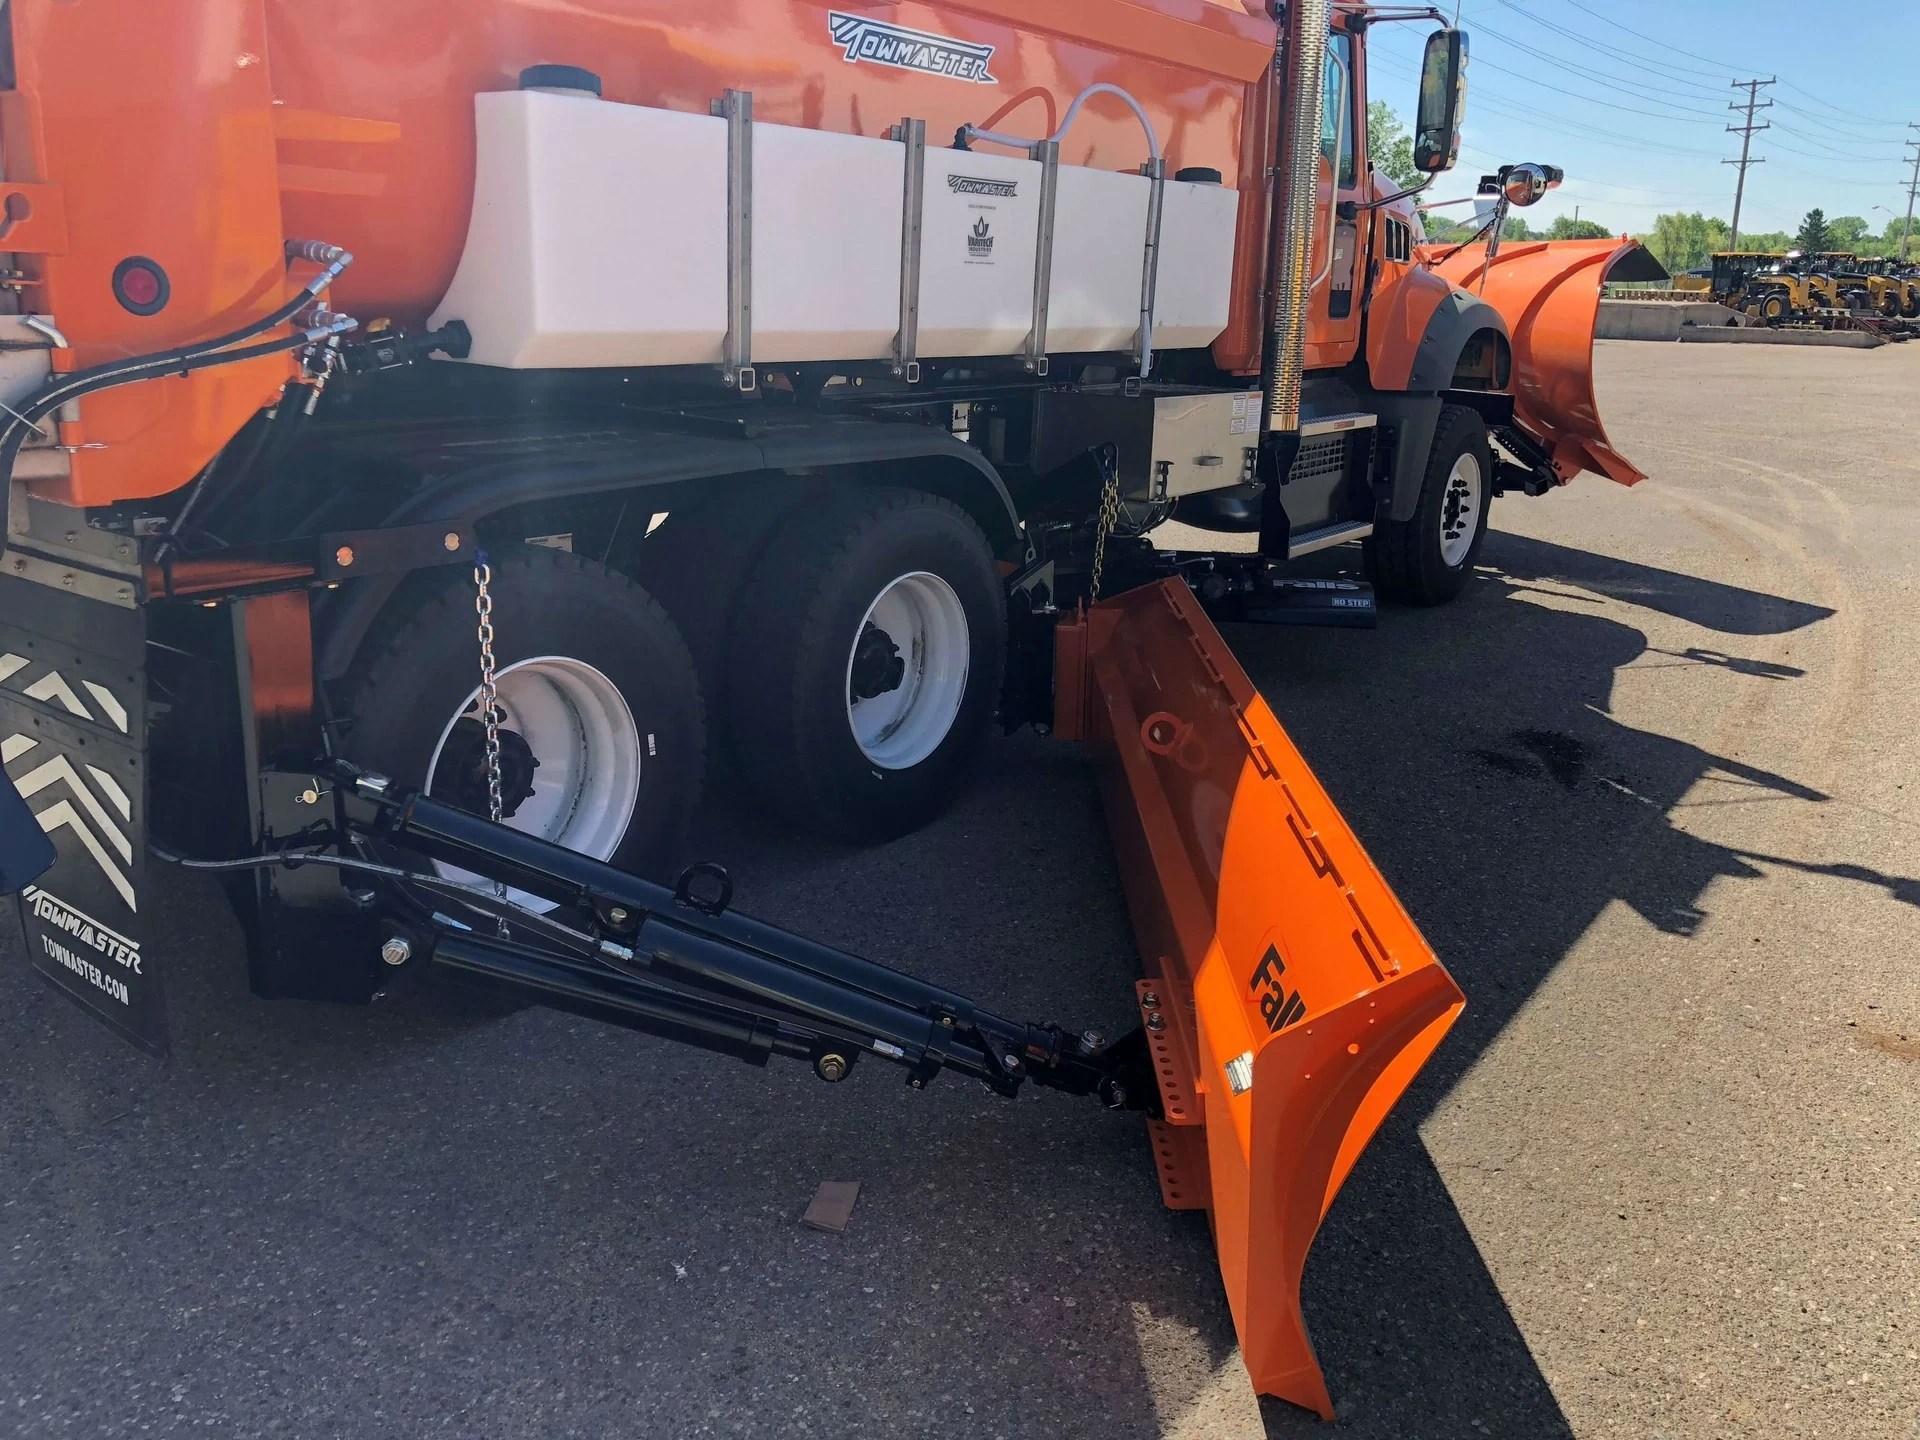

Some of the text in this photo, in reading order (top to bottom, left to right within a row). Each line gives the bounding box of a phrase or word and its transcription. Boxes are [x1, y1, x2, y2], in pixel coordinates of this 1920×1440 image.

[829, 11, 997, 82] TOWMASTER
[948, 174, 1018, 197] TOWMASTER
[1347, 599, 1369, 607] STEP
[22, 884, 143, 975] TOWMASTER
[41, 933, 129, 1006] TOWMASTER.COM
